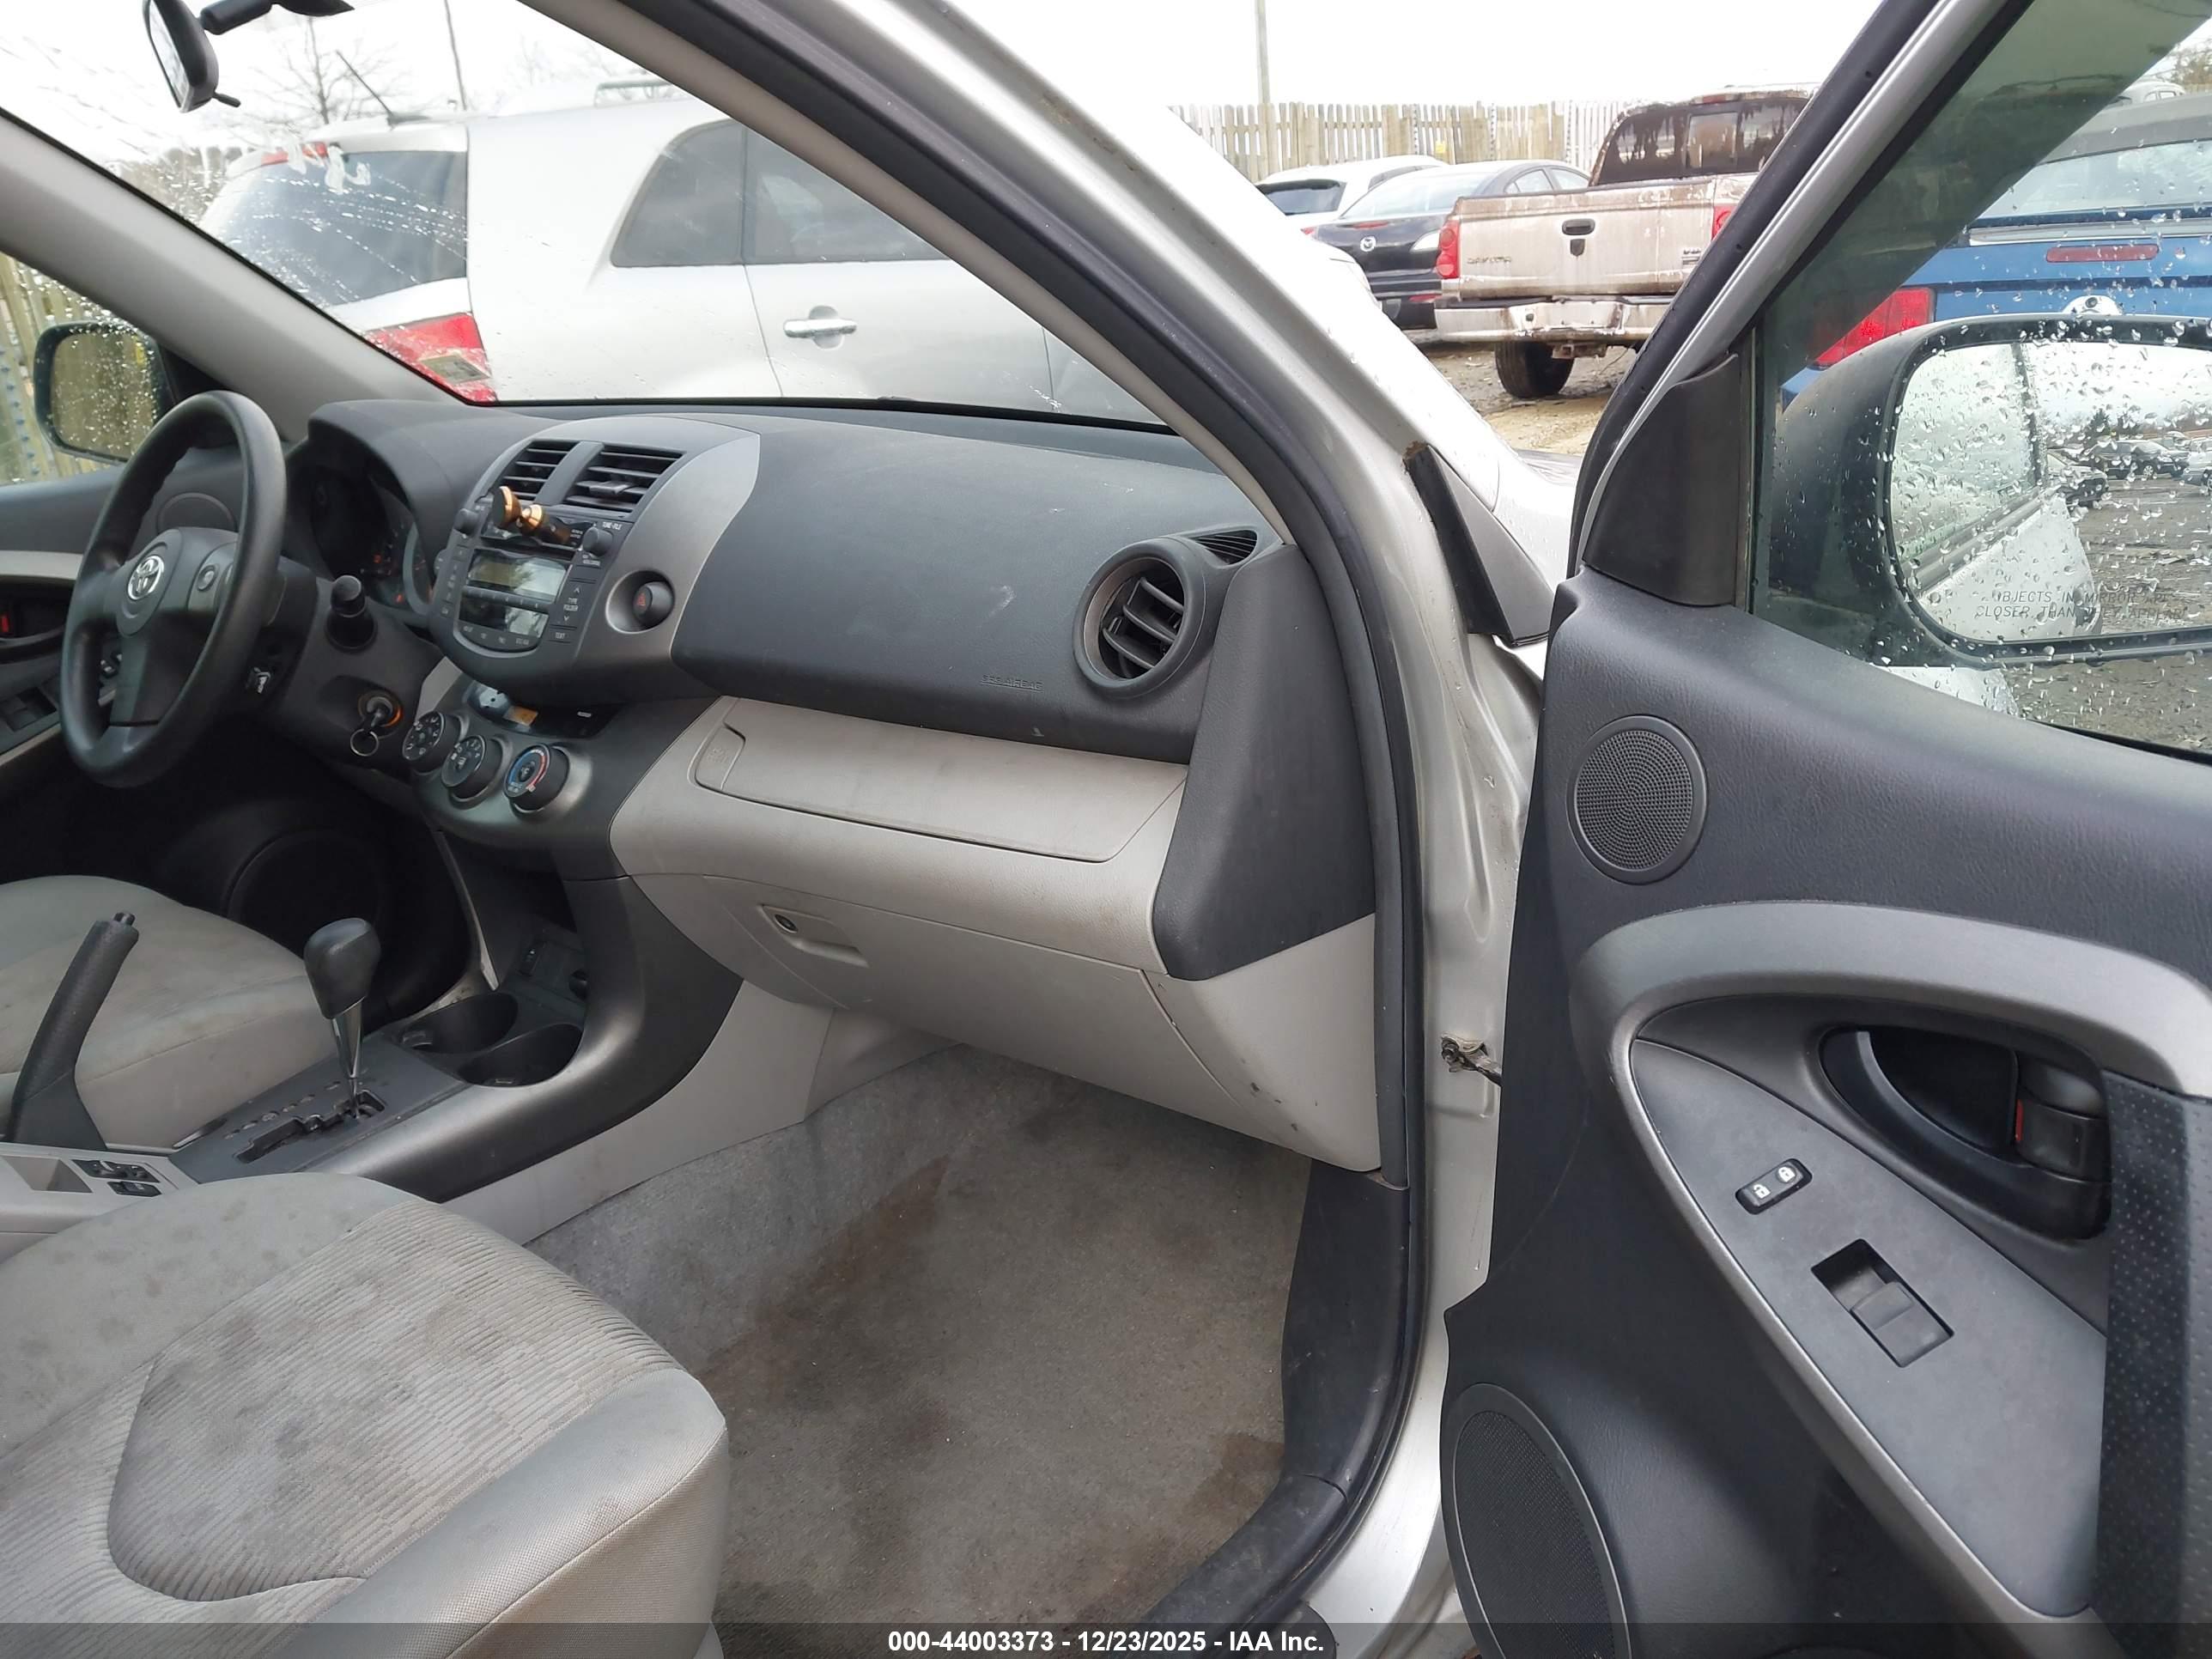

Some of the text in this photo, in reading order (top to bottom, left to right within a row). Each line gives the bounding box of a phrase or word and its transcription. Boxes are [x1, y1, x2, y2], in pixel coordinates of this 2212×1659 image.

[2062, 590, 2075, 603] IN
[1975, 605, 2030, 617] CLOSER
[2040, 605, 2075, 617] THAN
